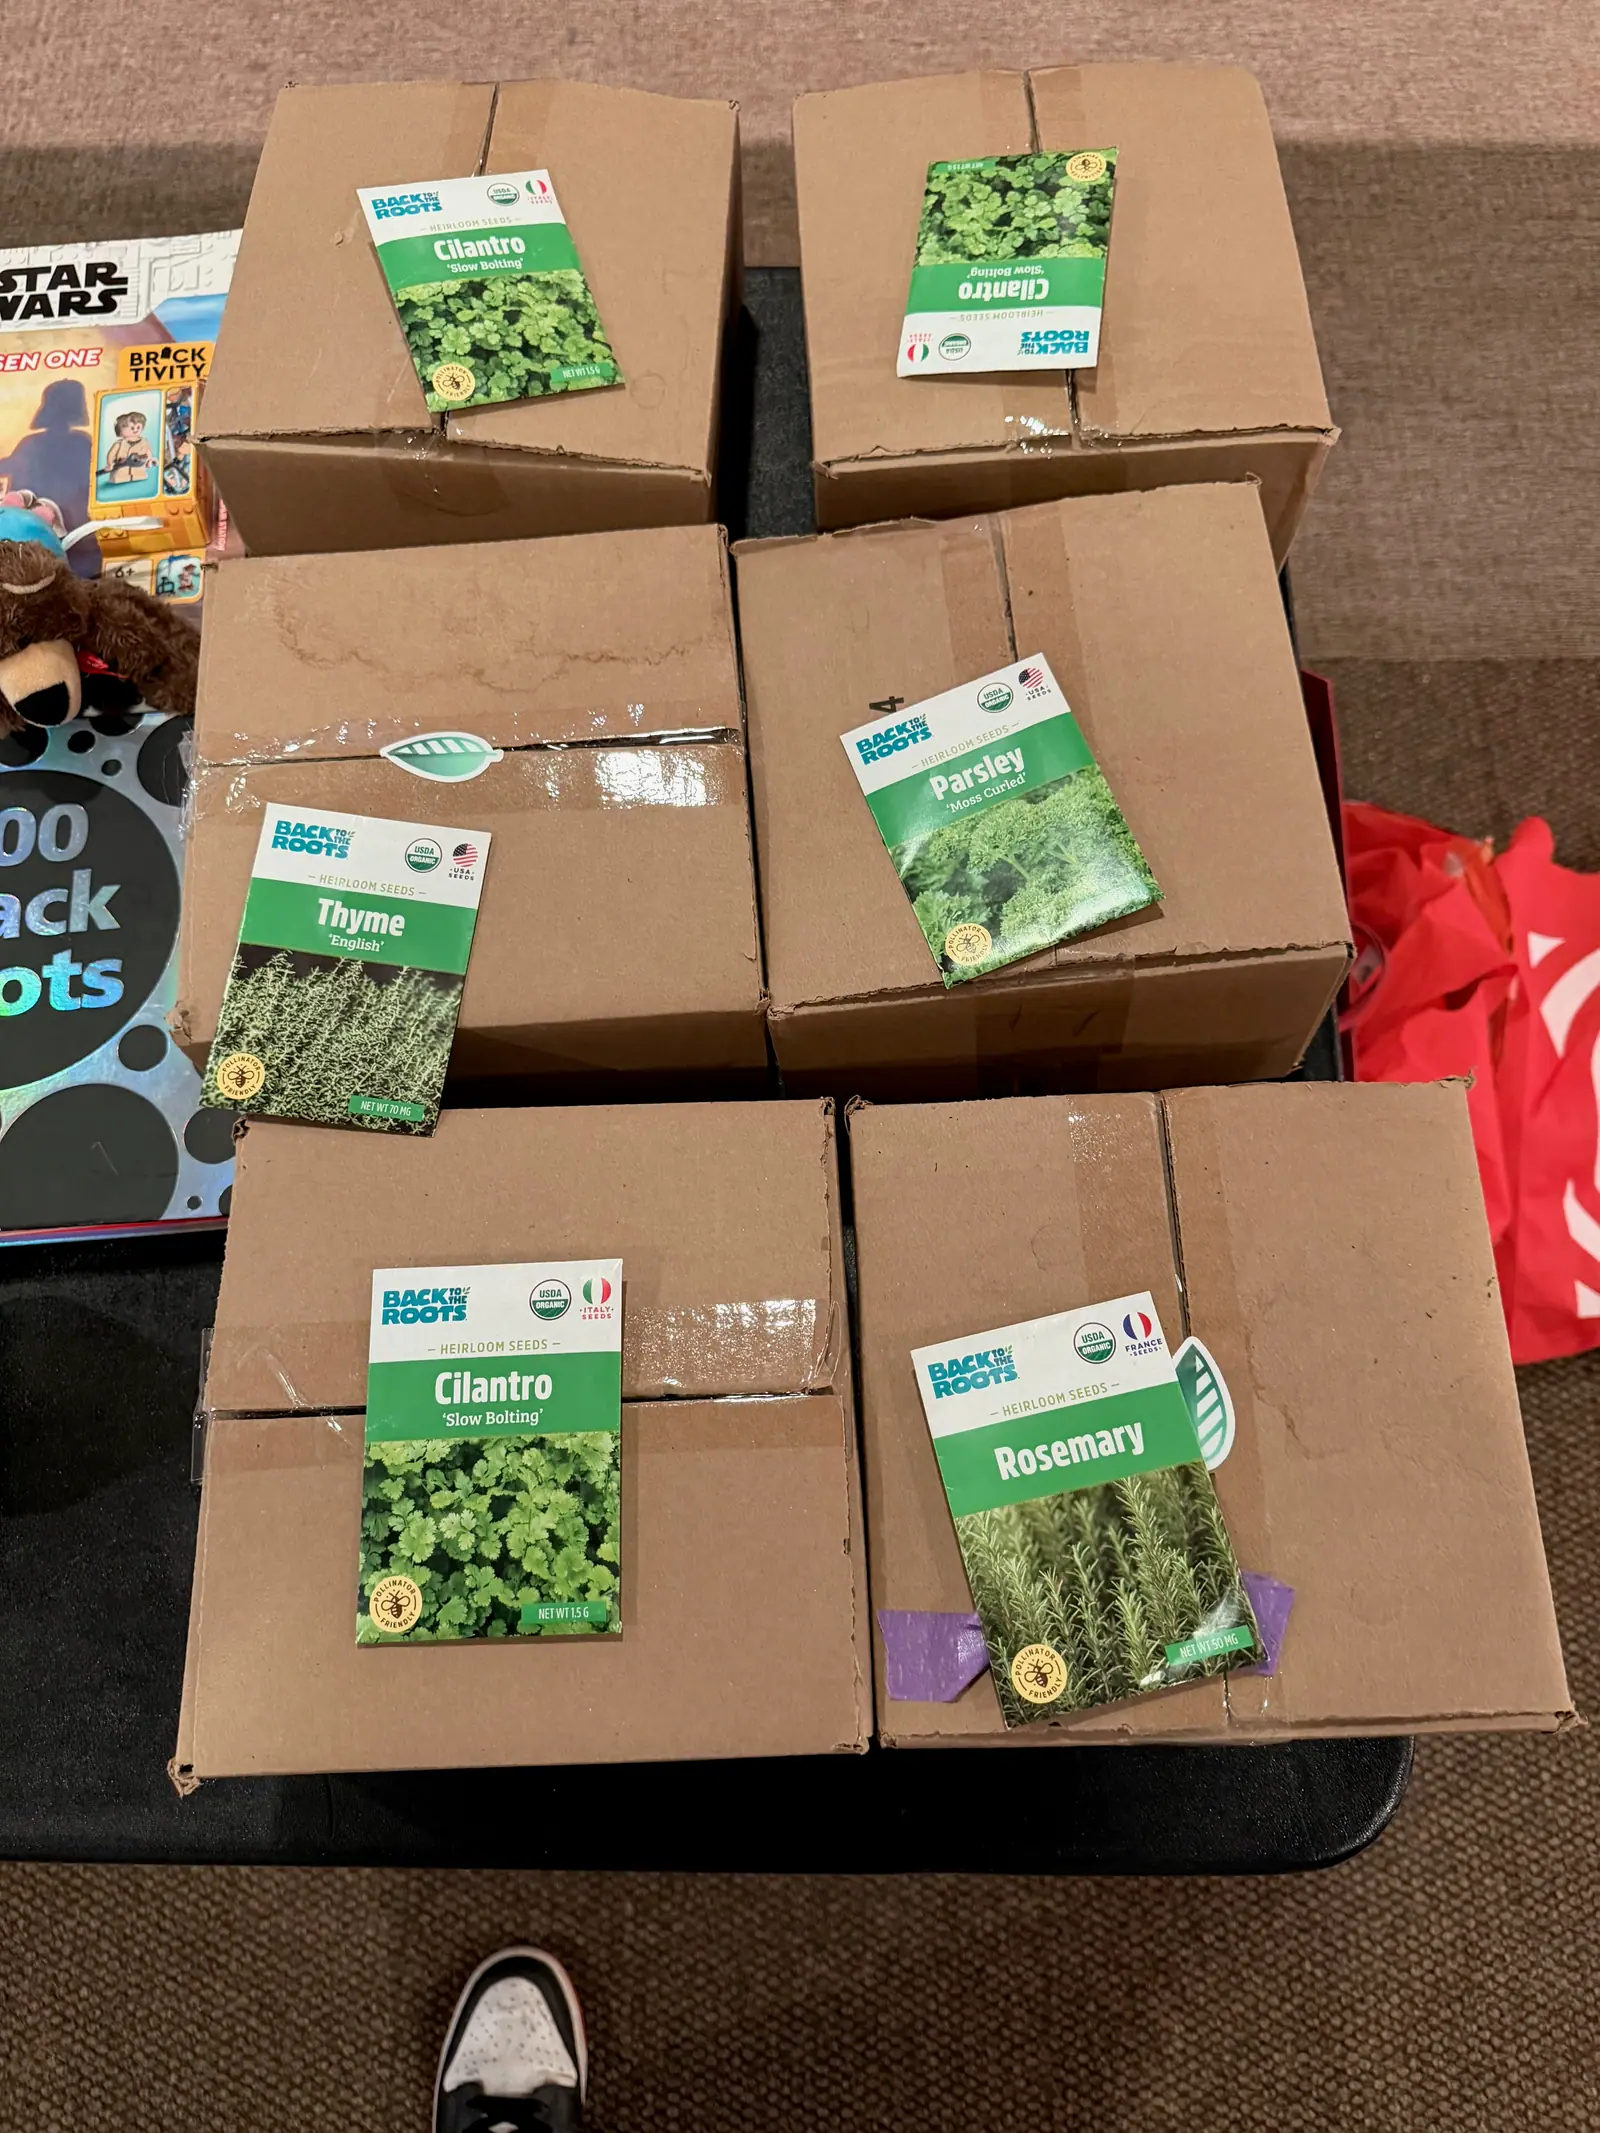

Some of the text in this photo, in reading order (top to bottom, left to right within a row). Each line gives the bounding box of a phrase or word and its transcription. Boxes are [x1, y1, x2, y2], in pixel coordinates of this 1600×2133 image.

[372, 193, 425, 210] BACK
[375, 202, 443, 220] ROOTS
[430, 216, 512, 232] HEIRLOOM SEEDS
[433, 236, 526, 261] Cilantro
[0, 262, 128, 294] STAR
[958, 278, 1049, 301] Cilantro
[960, 310, 1044, 321] HEIRLOOM SEEDS
[1021, 330, 1090, 343] ROOTS
[1036, 342, 1088, 354] BACK
[0, 348, 103, 372] EN ONE
[130, 363, 206, 382] TIVITY
[562, 369, 575, 378] NET
[575, 367, 586, 377] WT
[115, 567, 134, 578] 6+
[983, 687, 1004, 700] USDA
[856, 717, 920, 752] BACK TO
[911, 720, 927, 731] THE
[860, 727, 933, 766] ROOTS
[921, 724, 1010, 768] HEIRLOOM SEEDS
[929, 748, 1025, 801] Parsley
[274, 820, 347, 843] BACK TO
[334, 835, 351, 846] THE
[271, 835, 350, 860] ROOTS
[414, 845, 435, 856] USDA
[409, 855, 436, 865] ORGANIC
[319, 875, 415, 896] HEIRLOOM SEEDS
[449, 873, 475, 881] SEEDS
[318, 898, 405, 937] Thyme
[948, 926, 982, 949] POLLINATOR
[961, 944, 988, 962] FRIENDLY
[222, 1056, 261, 1072] POLLINATOR
[224, 1084, 256, 1096] FRIENDLY
[360, 1101, 412, 1116] NET WT 70 MG
[383, 1287, 461, 1307] BACK TO
[449, 1295, 467, 1305] THE
[539, 1289, 562, 1299] USDA
[535, 1300, 565, 1310] ORGANIC
[381, 1305, 467, 1325] ROOTS
[440, 1339, 548, 1354] HEIRLOOM SEEDS
[1081, 1331, 1105, 1344] USDA
[1125, 1338, 1163, 1352] FRANCE
[1082, 1342, 1112, 1355] ORGANIC
[927, 1347, 1005, 1382] BACK TO
[994, 1355, 1014, 1367] THE
[435, 1371, 553, 1405] Cilantro
[932, 1365, 1018, 1400] ROOTS
[1002, 1382, 1108, 1417] HEIRLOOM SEEDS
[994, 1422, 1145, 1481] Rosemary
[374, 1580, 416, 1603] POLLINATOR
[380, 1610, 416, 1629] FRIENDLY
[538, 1606, 589, 1619] NET WT 1.5 G
[1179, 1647, 1197, 1659] NET
[1197, 1642, 1211, 1655] WT
[1225, 1633, 1239, 1647] MG
[1015, 1648, 1056, 1676] POLLINATOR
[1028, 1677, 1062, 1699] FRIENDLY
